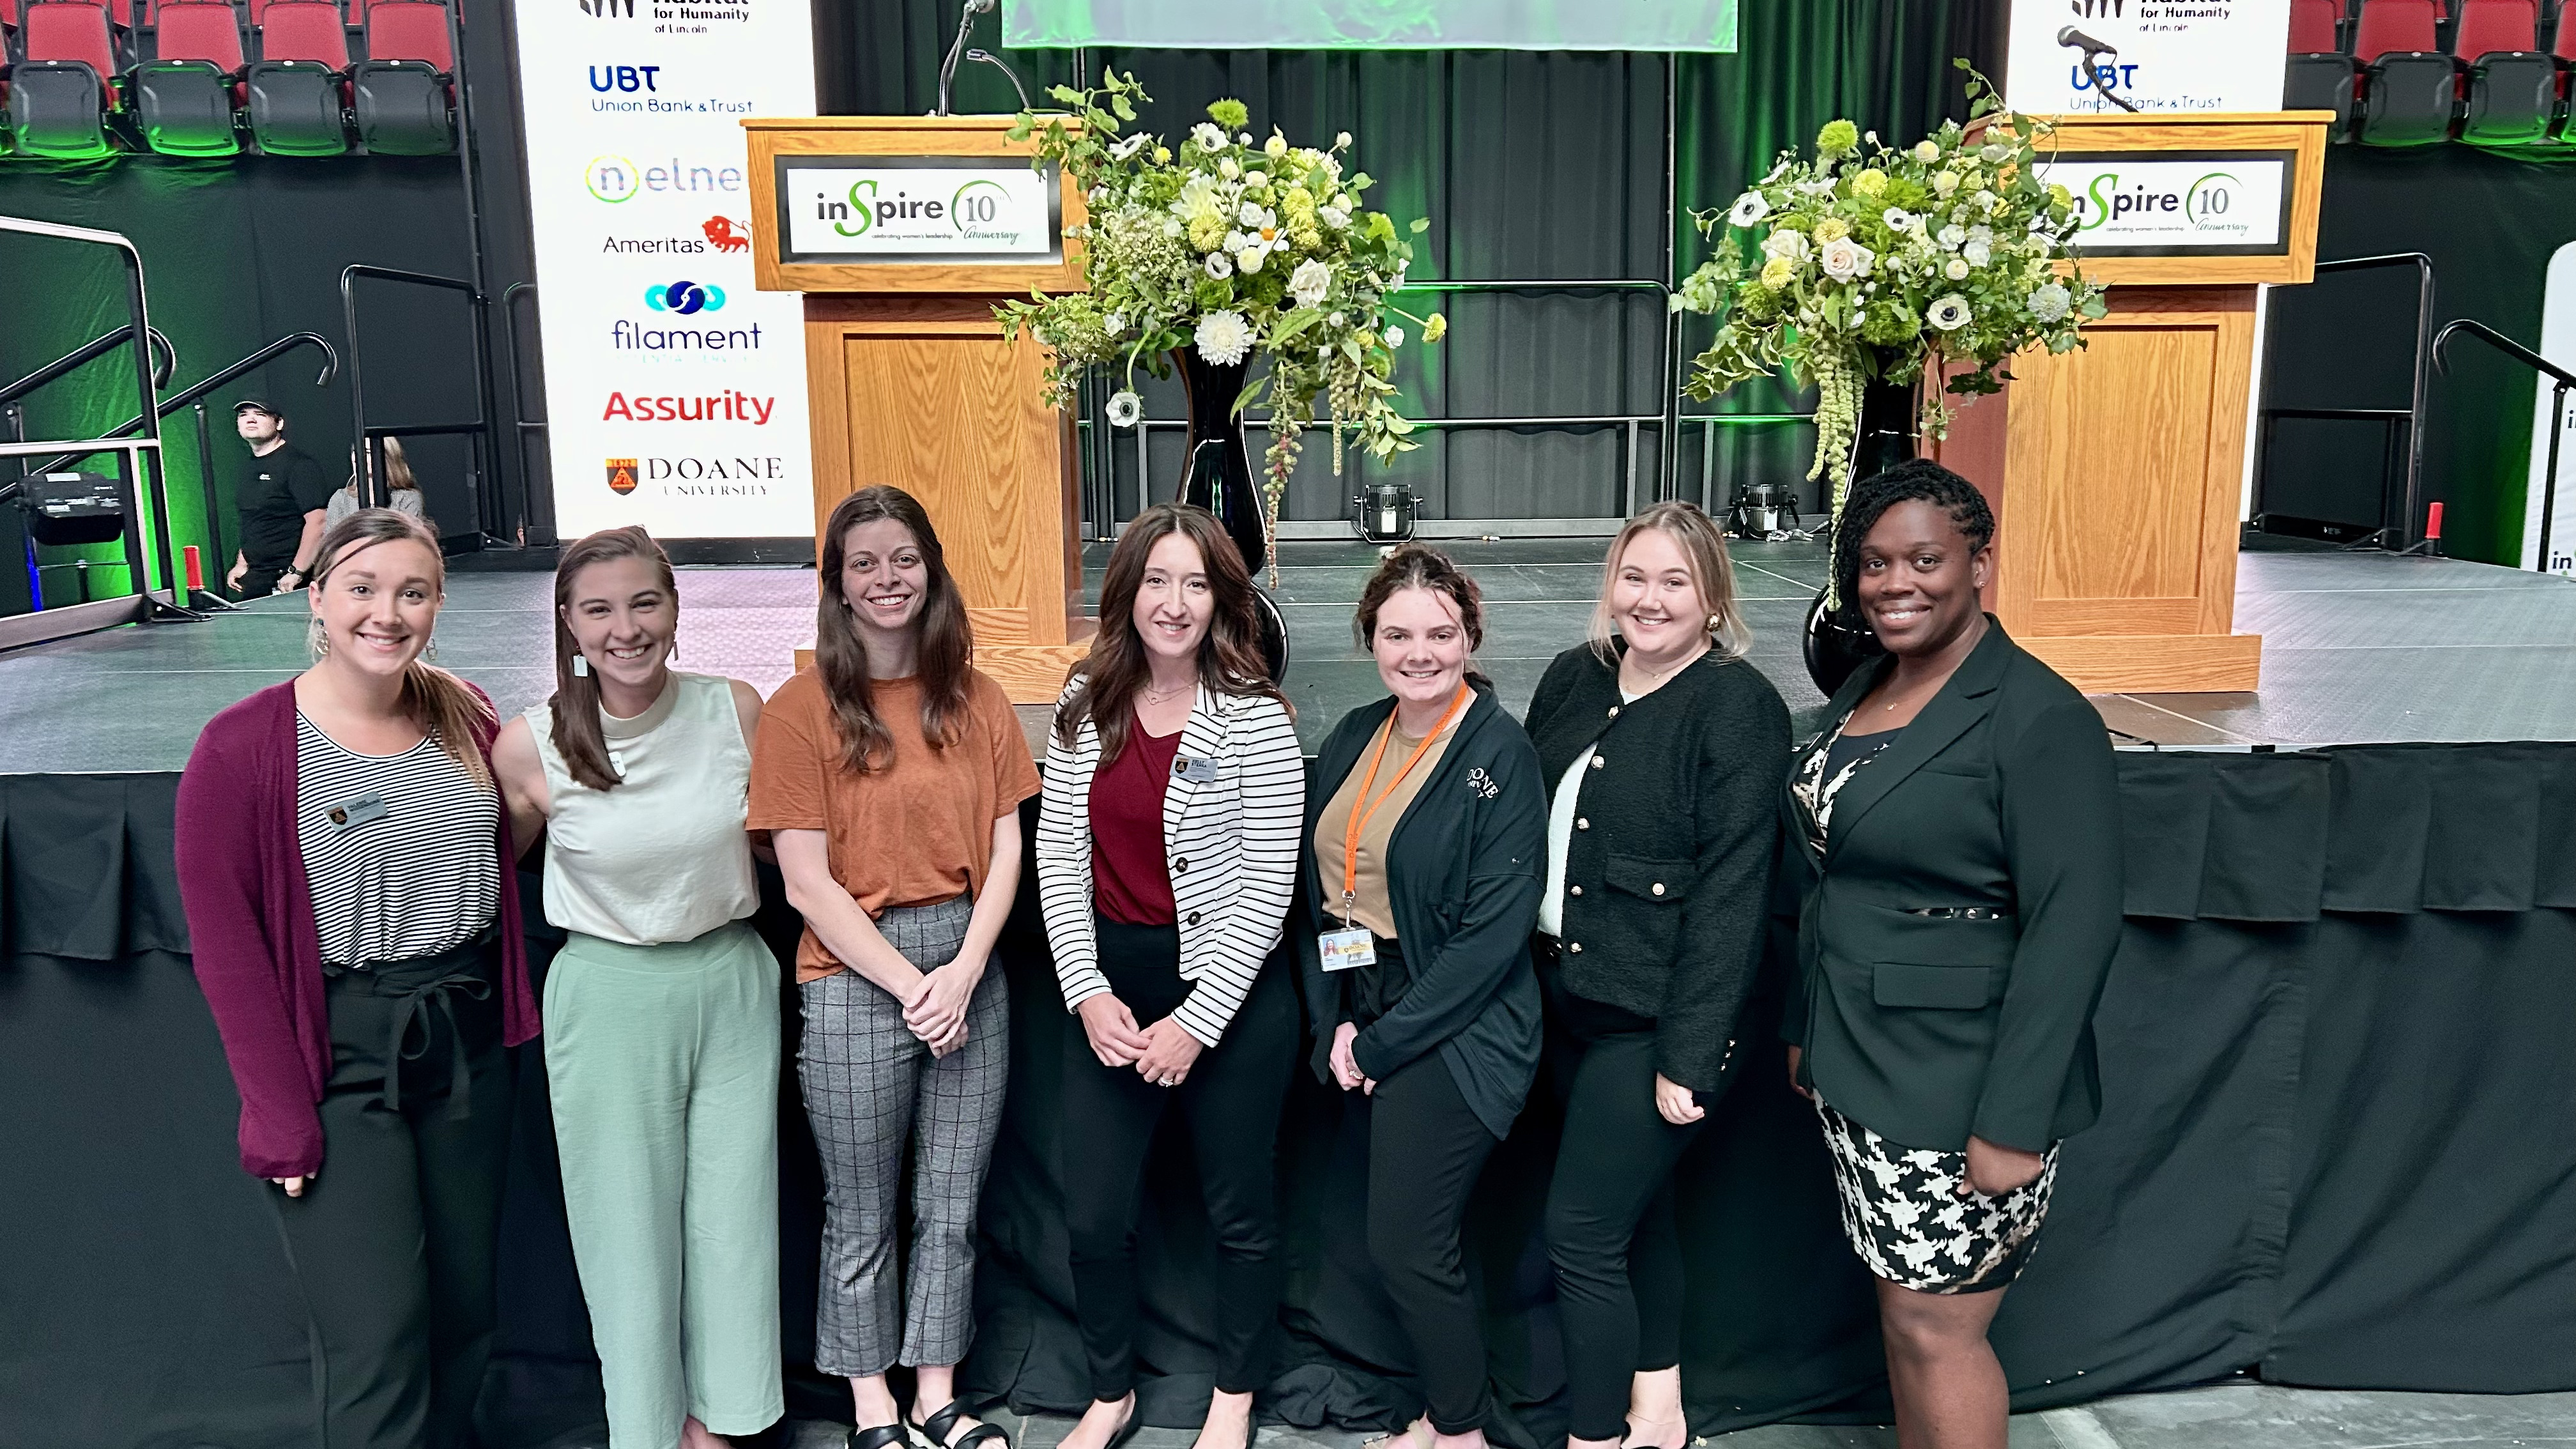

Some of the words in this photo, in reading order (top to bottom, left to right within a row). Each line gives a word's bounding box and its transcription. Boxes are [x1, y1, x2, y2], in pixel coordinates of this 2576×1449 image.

[654, 8, 673, 19] for
[680, 8, 749, 22] Humanity
[2141, 7, 2159, 18] for
[2166, 6, 2230, 20] Humanity
[655, 24, 664, 33] of
[669, 24, 707, 33] Lincoln
[589, 65, 660, 93] UBT
[2071, 65, 2139, 91] UBT
[592, 98, 643, 112] Union
[648, 98, 693, 112] Bank
[699, 103, 707, 112] &
[710, 99, 753, 112] Trust
[2070, 97, 2117, 111] Union
[2170, 100, 2178, 109] &
[2182, 96, 2222, 109] Trust
[600, 157, 742, 192] nelne
[816, 179, 944, 237] inSpire
[2070, 173, 2179, 231] nSpire
[603, 236, 704, 254] Ameritas
[611, 319, 762, 349] filament
[602, 389, 775, 425] Assurity
[648, 457, 784, 479] DOANE
[664, 485, 767, 496] UNIVERSITY
